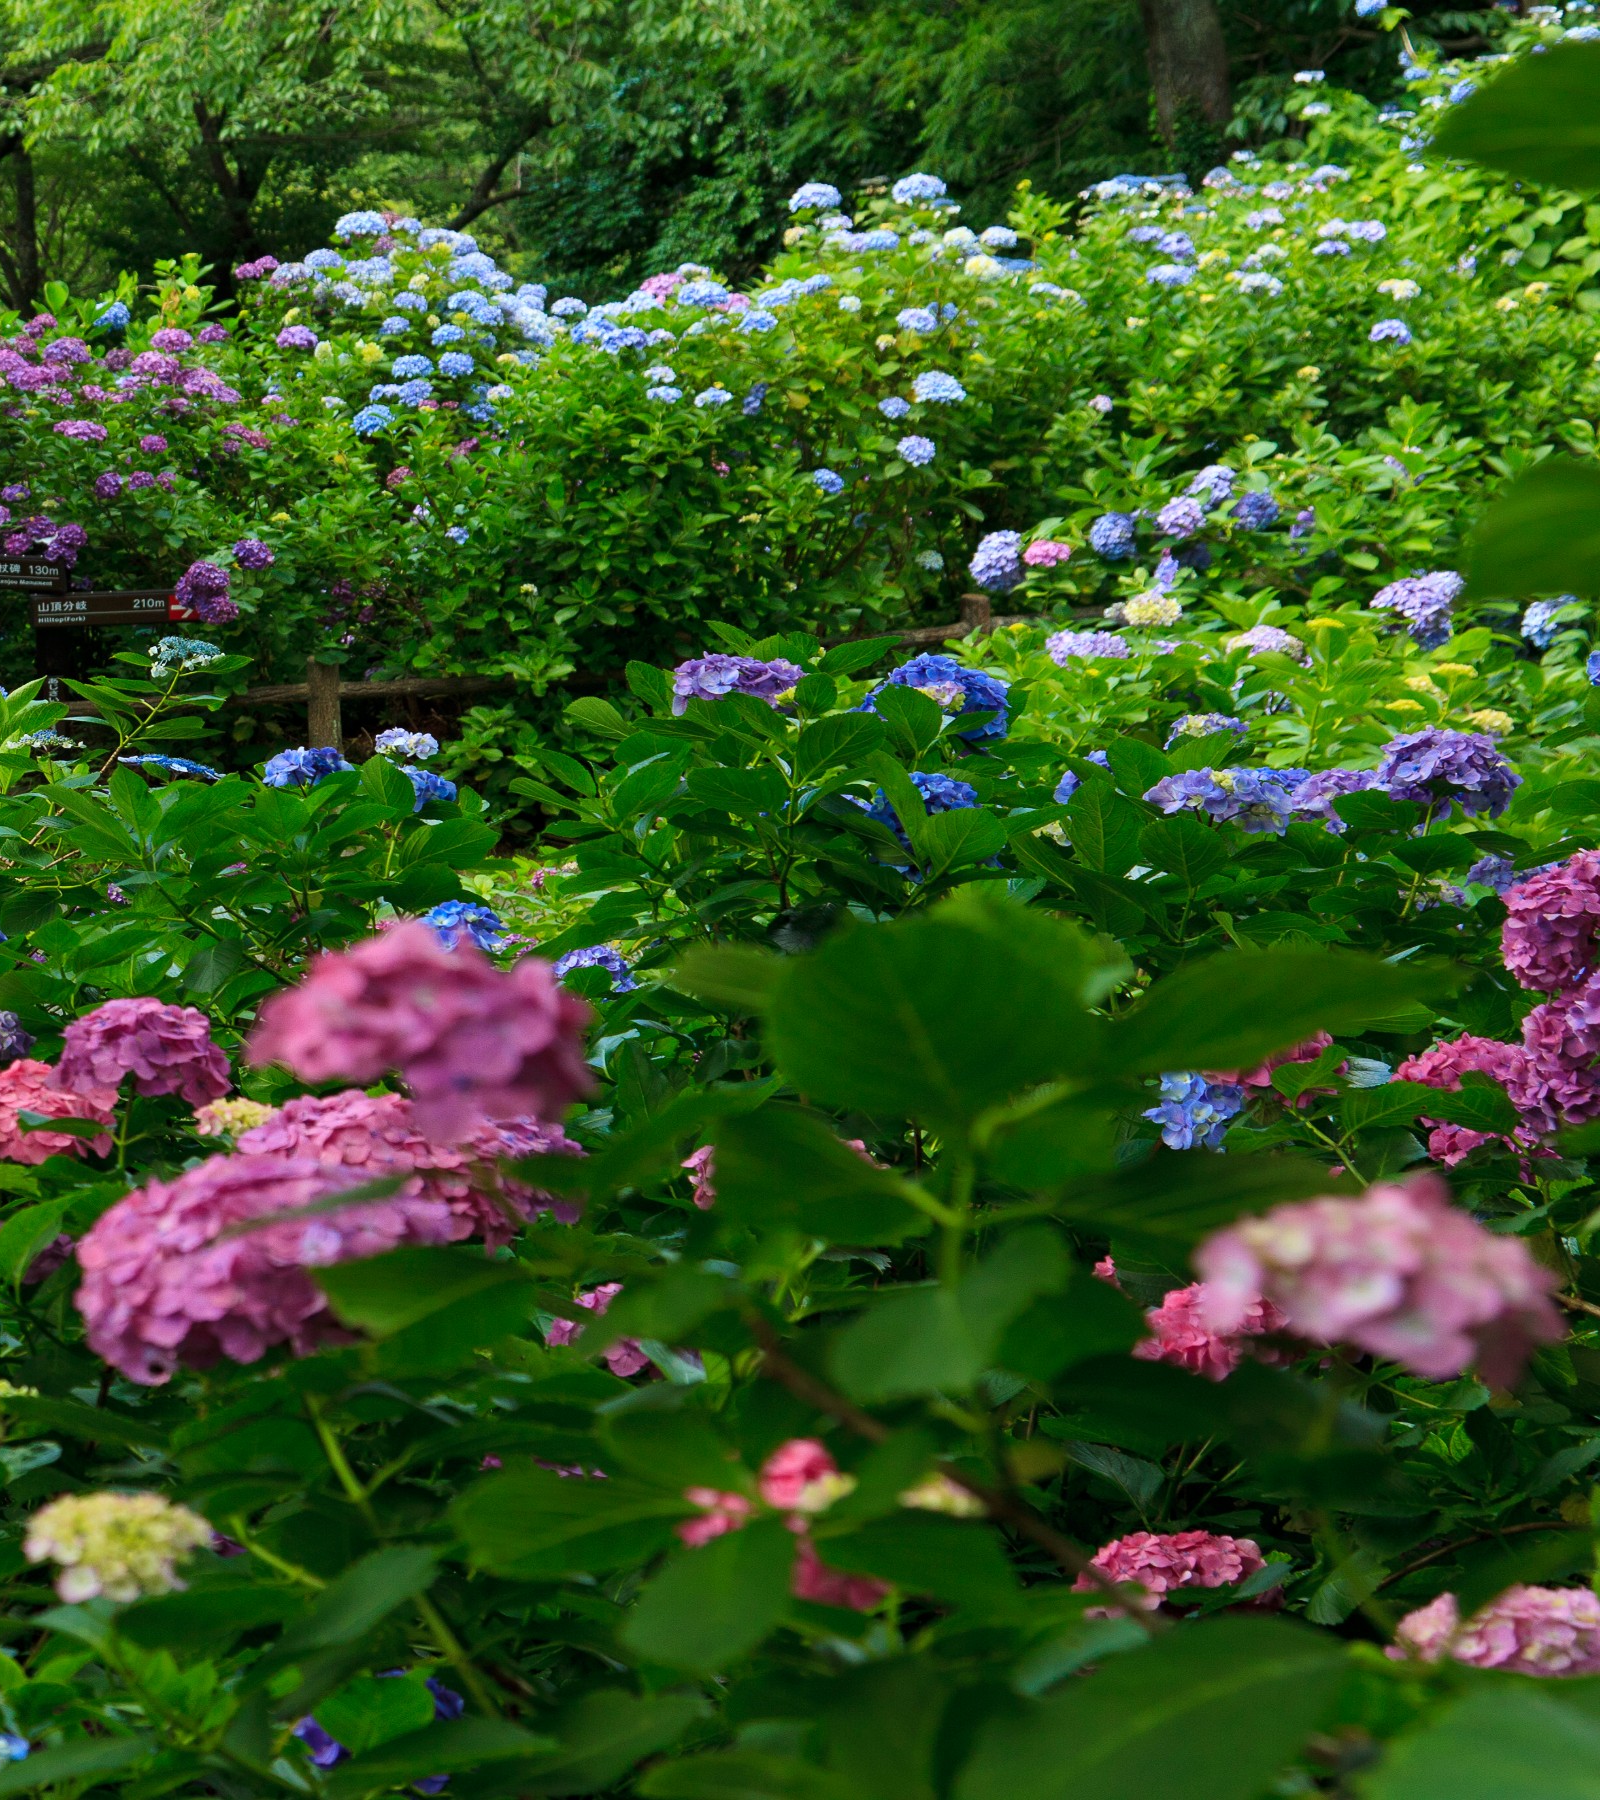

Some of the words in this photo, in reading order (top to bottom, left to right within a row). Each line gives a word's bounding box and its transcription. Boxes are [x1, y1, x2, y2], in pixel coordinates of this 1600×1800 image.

[29, 565, 59, 575] 130m
[38, 600, 88, 612] 山頂分岐
[133, 598, 165, 609] 210m
